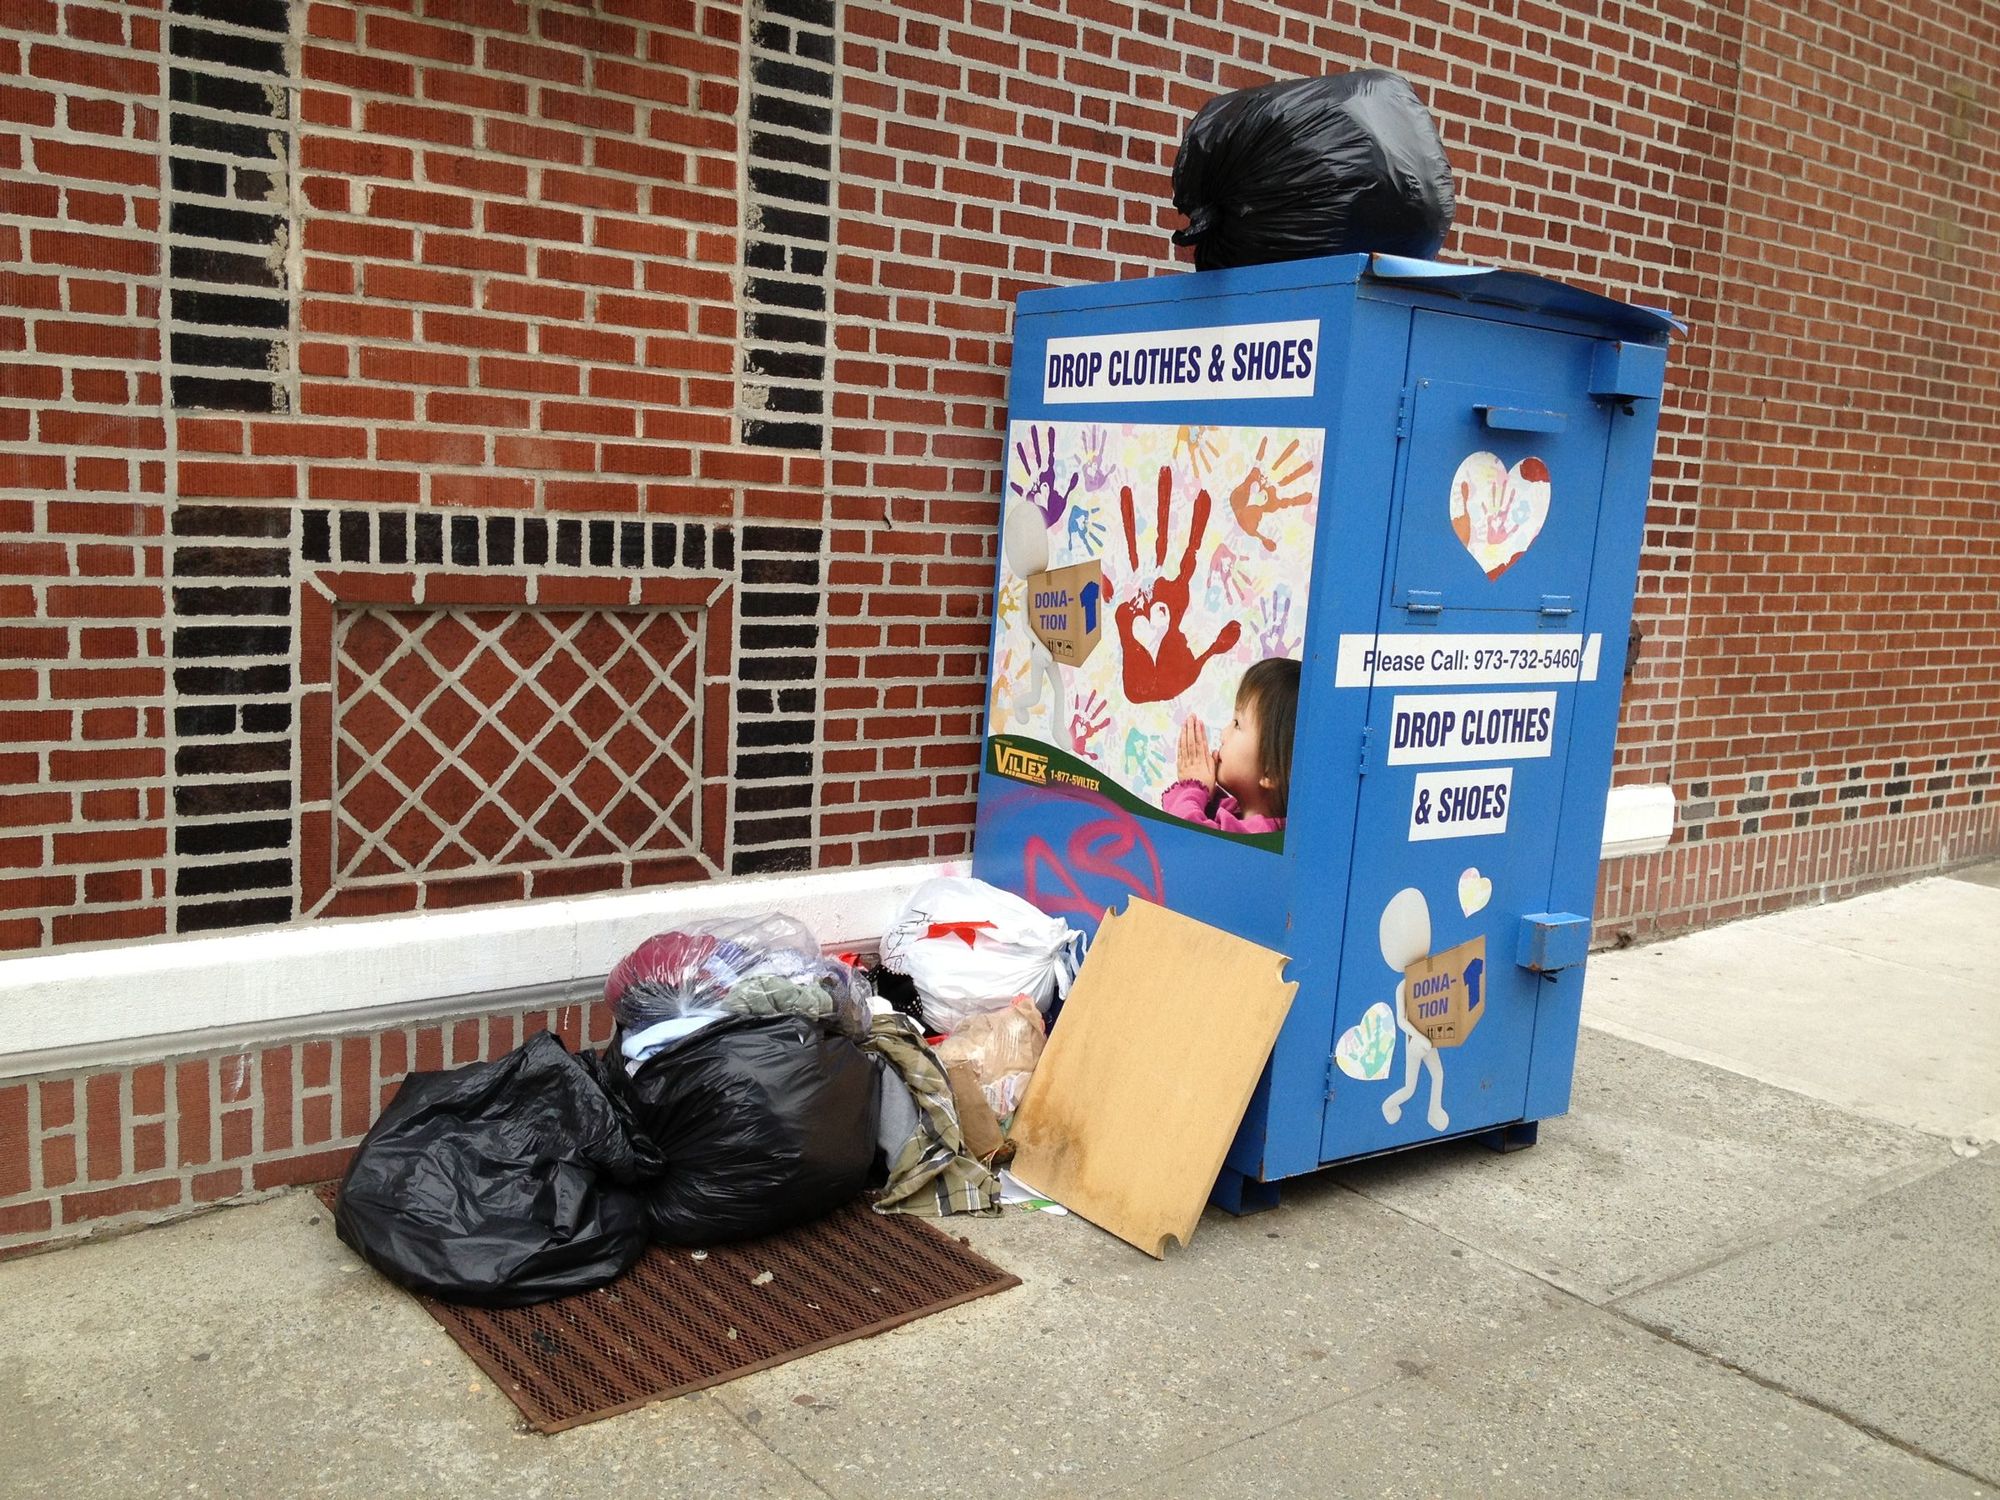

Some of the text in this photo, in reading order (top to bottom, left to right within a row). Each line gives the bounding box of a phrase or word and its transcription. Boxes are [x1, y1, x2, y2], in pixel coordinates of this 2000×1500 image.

[1048, 338, 1313, 388] DROP CLOTHES & SHOES
[1035, 590, 1074, 609] DONA-
[1039, 614, 1067, 630] TION
[1363, 649, 1580, 672] Please Call: 973-732-5460
[1394, 707, 1550, 749] DROP CLOTHES
[1415, 784, 1507, 825] & SHOES
[1413, 973, 1457, 999] DONA-
[1418, 997, 1449, 1019] TION
